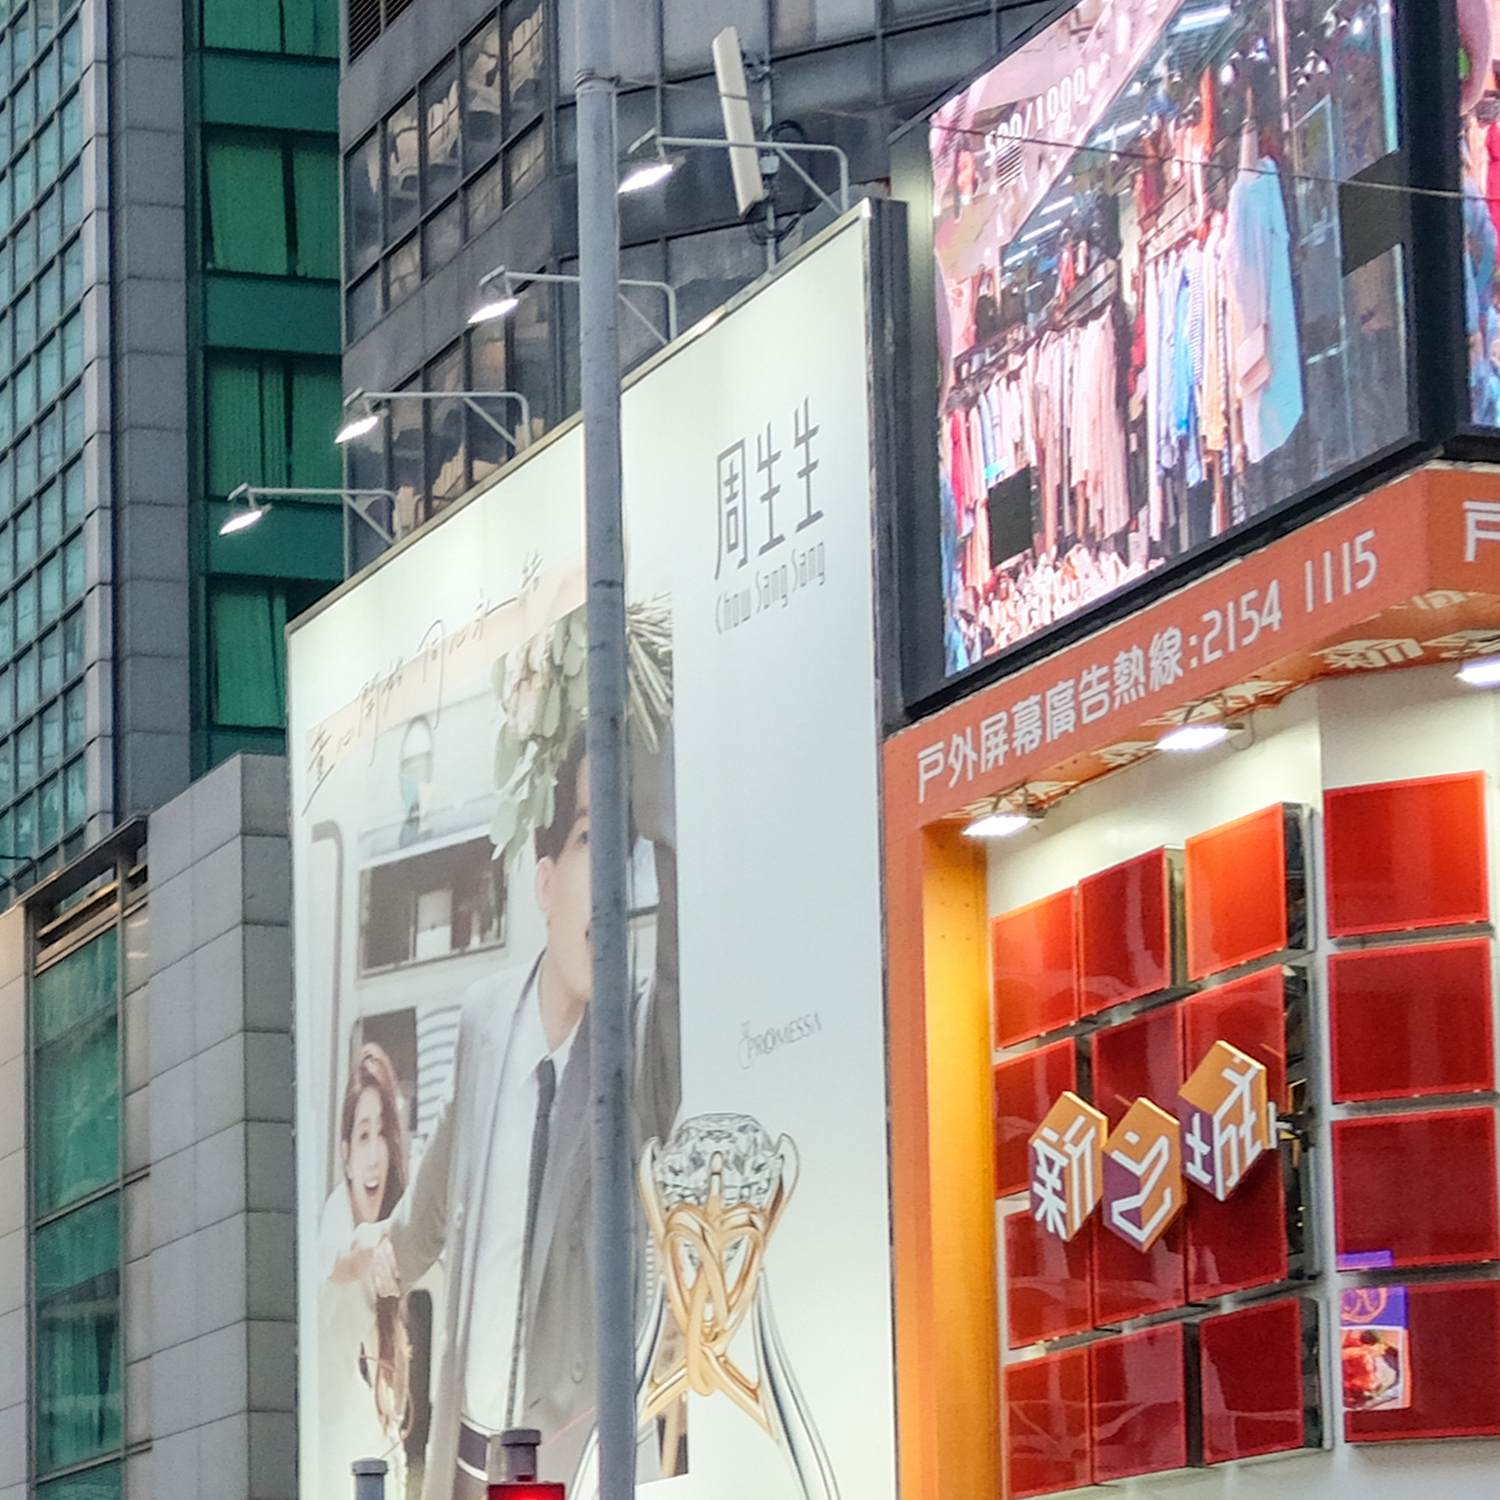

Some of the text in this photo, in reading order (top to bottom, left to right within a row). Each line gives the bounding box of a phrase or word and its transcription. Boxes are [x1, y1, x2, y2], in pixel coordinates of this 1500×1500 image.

[715, 541, 826, 635] Chow Sang Sang
[1304, 529, 1380, 612] 1115
